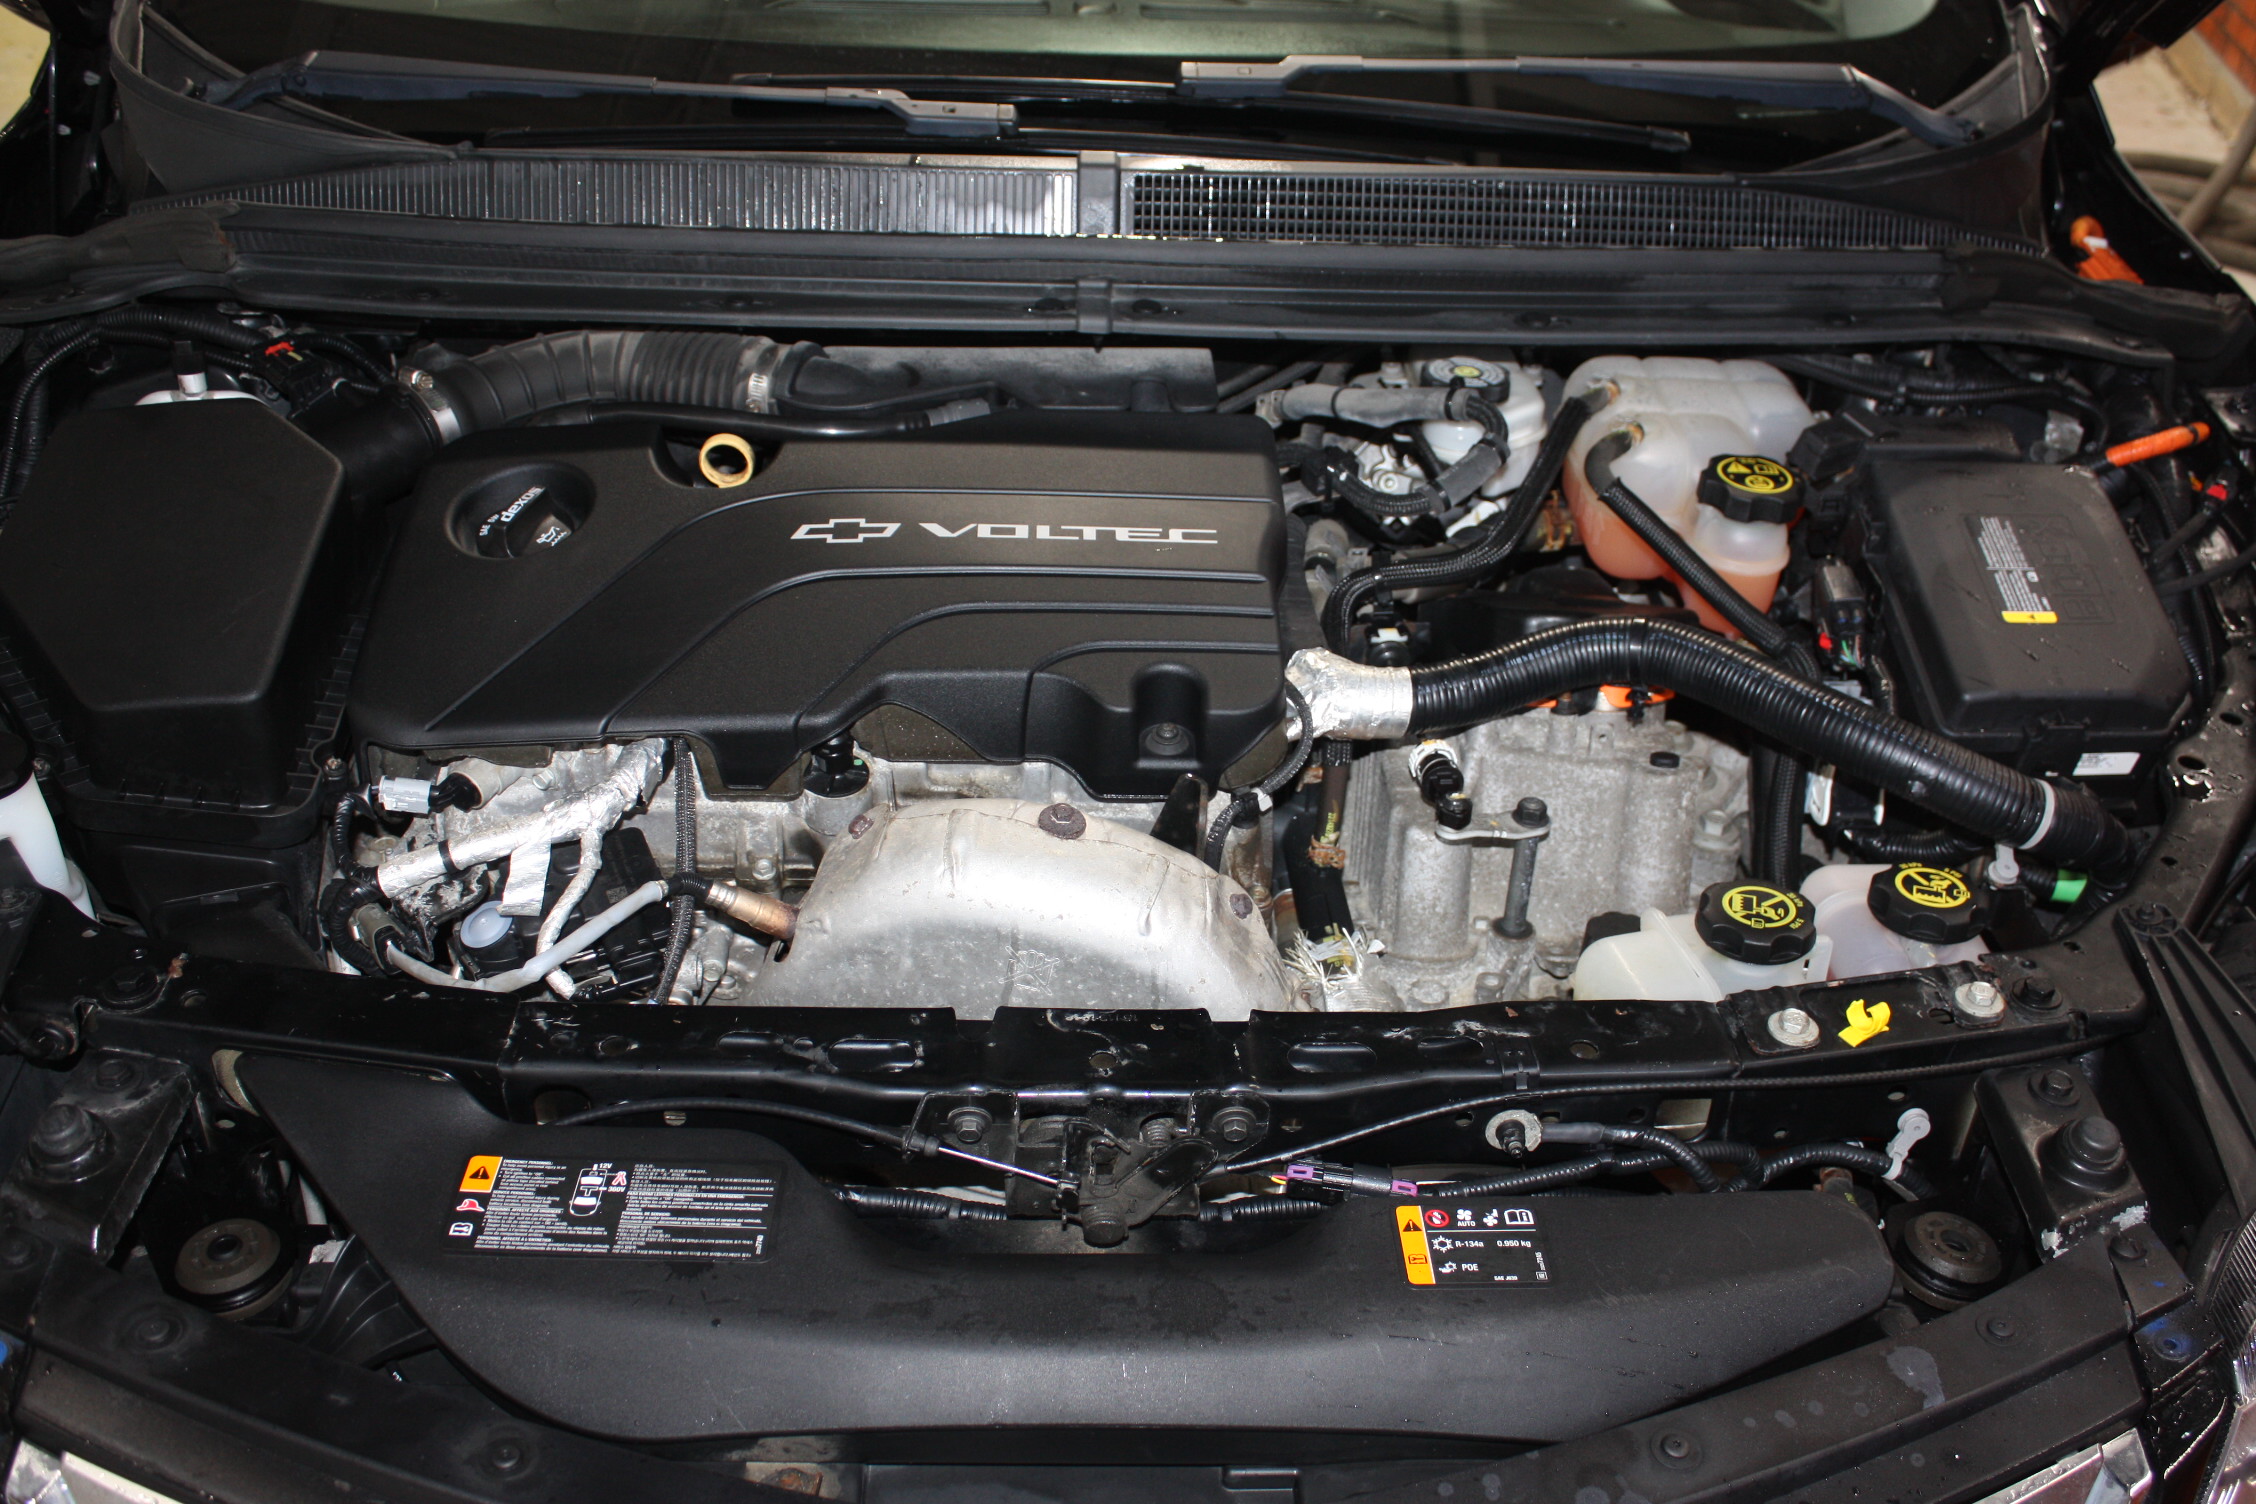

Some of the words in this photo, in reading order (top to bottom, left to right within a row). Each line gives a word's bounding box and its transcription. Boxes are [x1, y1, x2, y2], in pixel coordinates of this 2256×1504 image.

[500, 486, 545, 522] dexos
[918, 522, 1218, 544] VOLTEC
[1455, 1240, 1484, 1248] R-134a
[1520, 1240, 1532, 1248] kg
[1461, 1263, 1479, 1271] POE
